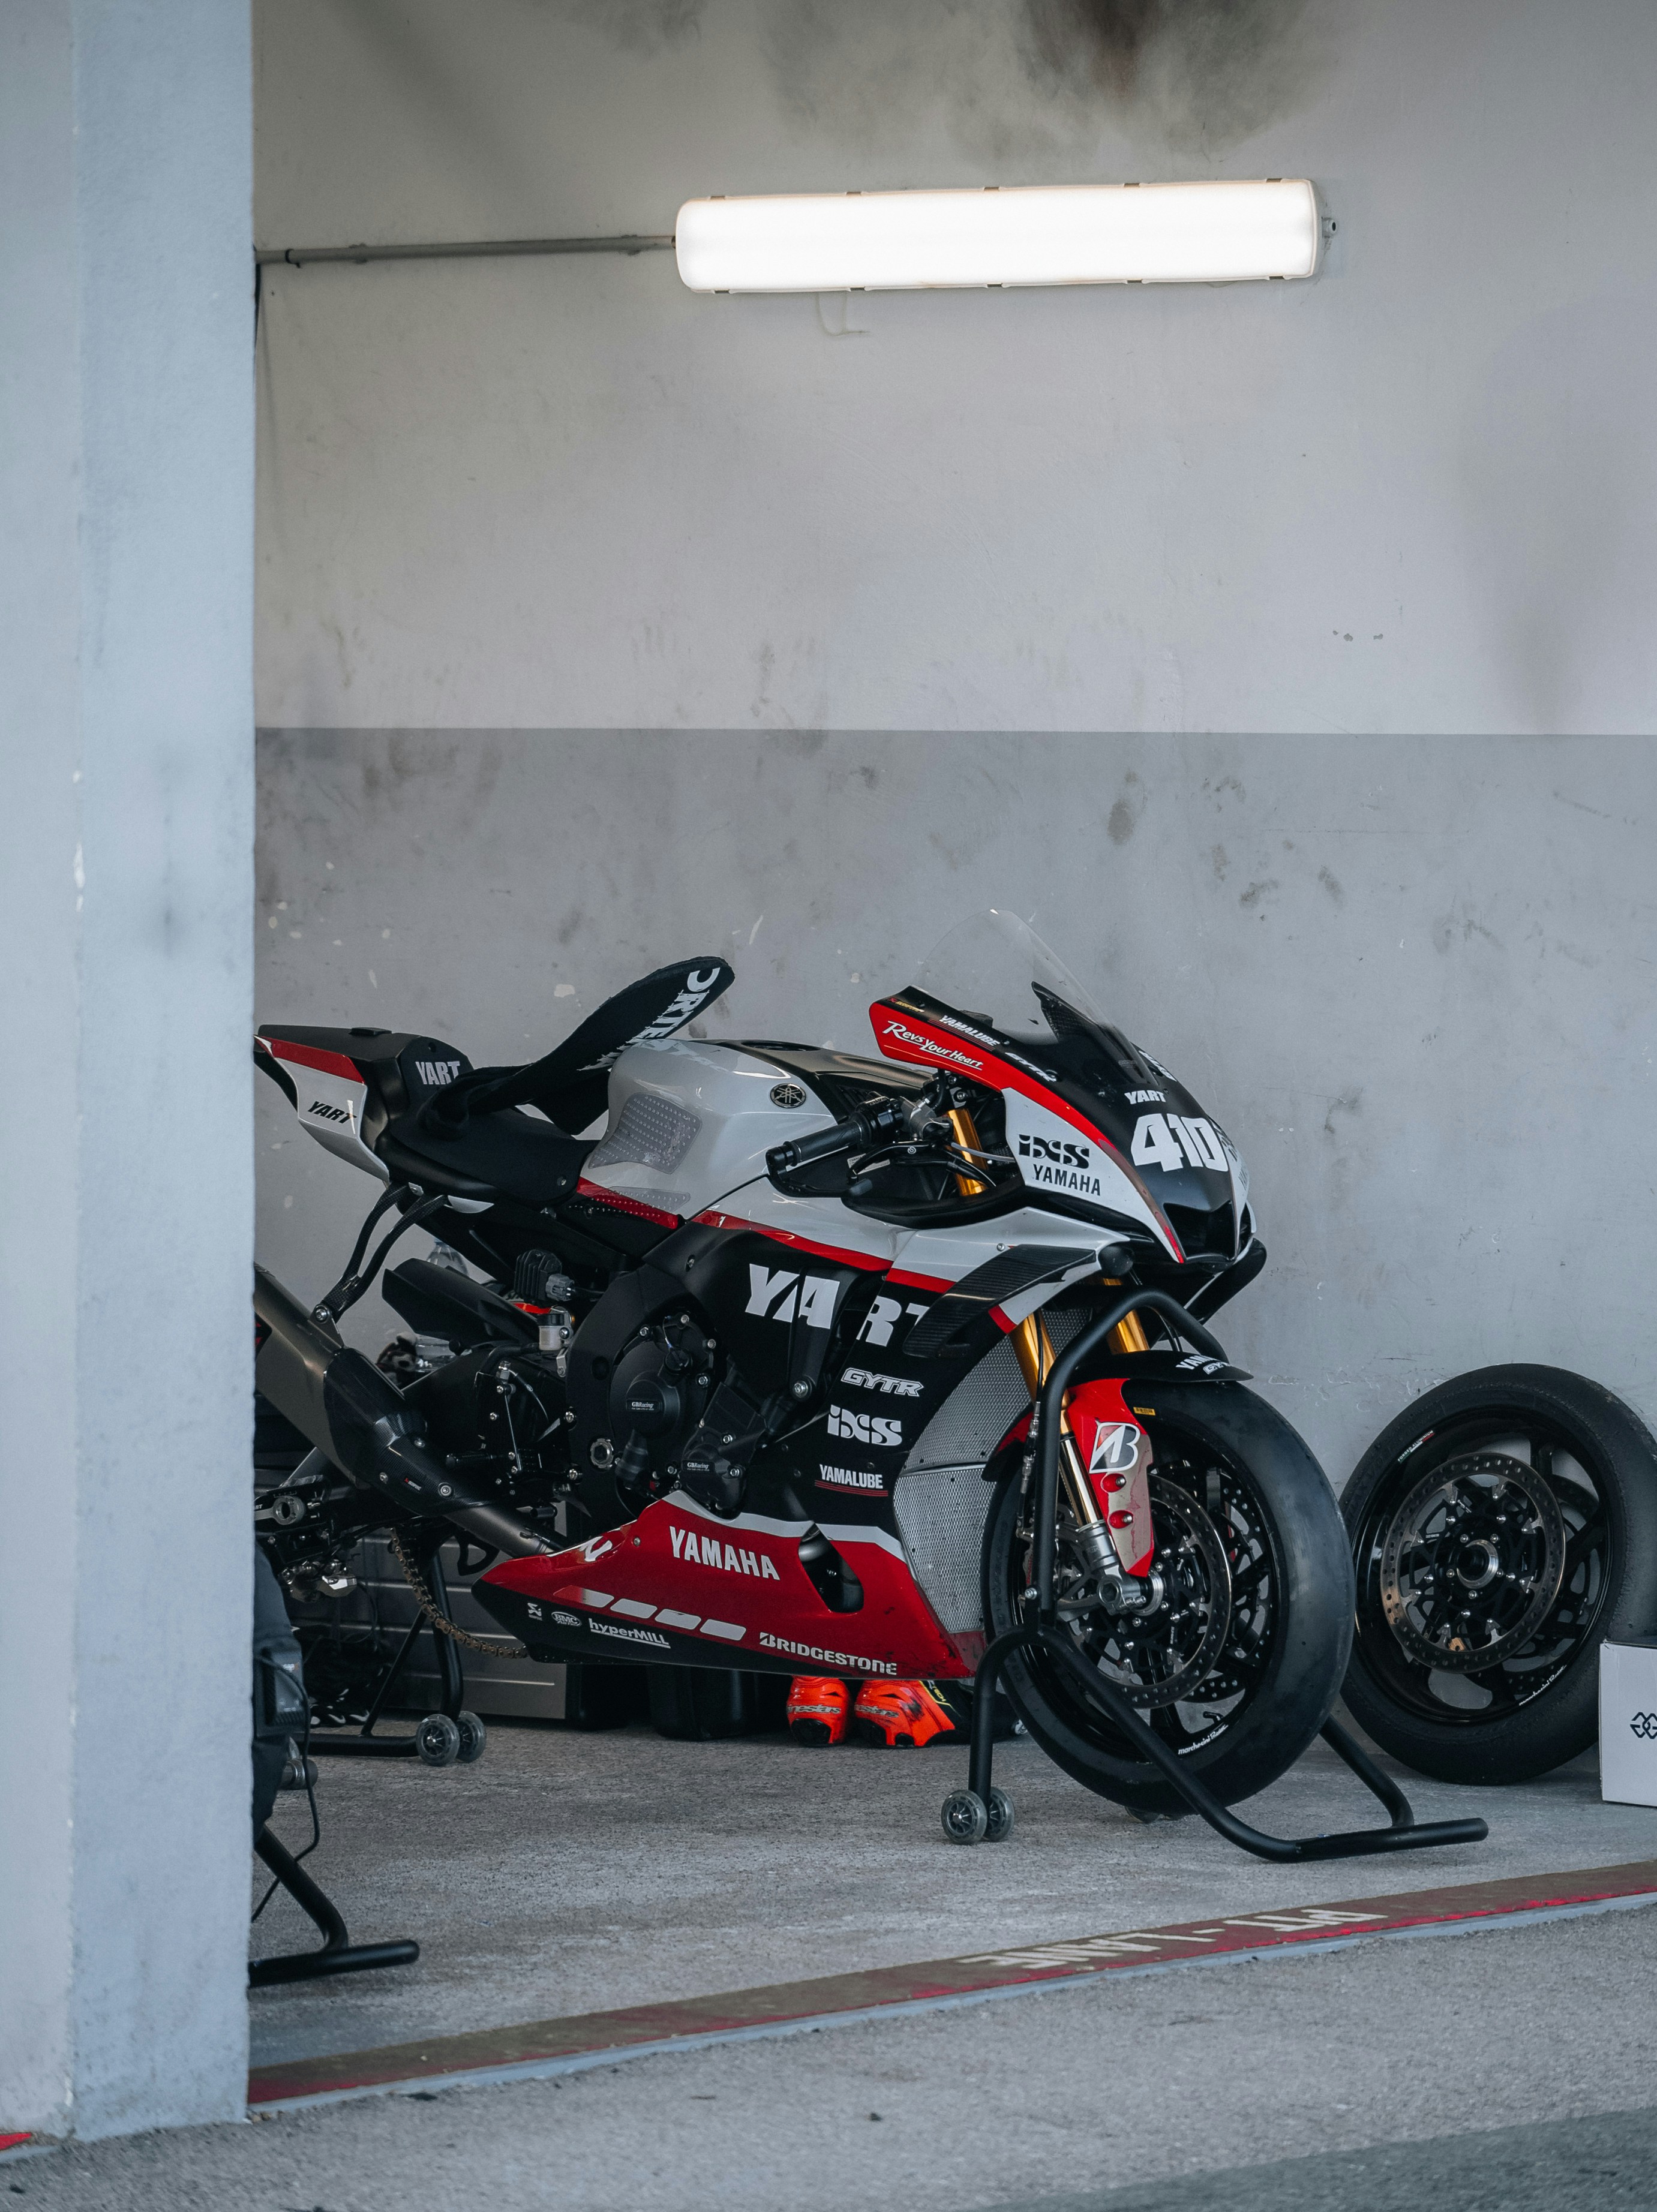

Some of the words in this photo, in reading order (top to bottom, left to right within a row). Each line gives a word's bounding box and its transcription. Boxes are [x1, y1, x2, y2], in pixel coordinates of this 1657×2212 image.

[939, 1015, 1000, 1047] YAMALUBE
[415, 1061, 461, 1085] YART
[1124, 1090, 1166, 1105] YART
[307, 1101, 357, 1124] YART
[1130, 1113, 1229, 1172] 410
[1033, 1164, 1100, 1196] YAMAHA
[841, 1367, 924, 1397] GYTR
[820, 1464, 883, 1489] YAMALUBE
[670, 1526, 781, 1580] YAMAHA
[554, 1613, 578, 1624] BMC
[589, 1618, 670, 1646] hyperMILL
[760, 1632, 897, 1675] BRIDGESTONE
